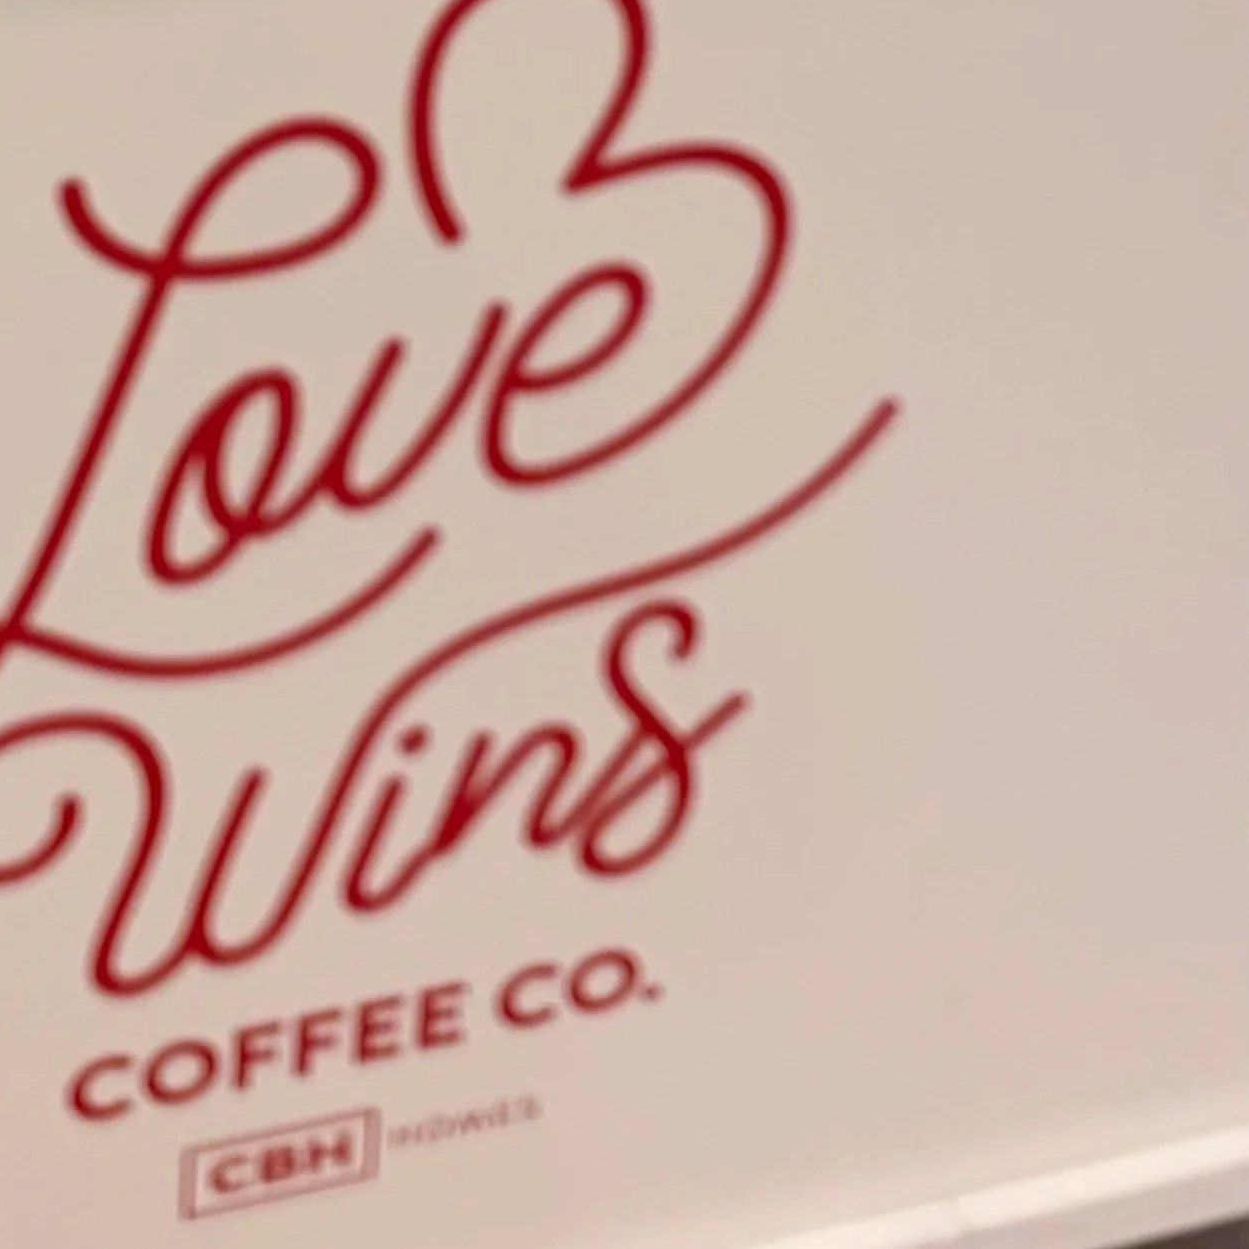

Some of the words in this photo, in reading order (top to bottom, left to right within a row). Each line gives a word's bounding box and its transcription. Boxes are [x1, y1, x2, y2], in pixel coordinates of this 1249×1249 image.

[63, 980, 470, 1123] COFFEE
[492, 944, 664, 1030] CO.
[207, 1130, 356, 1194] CBH
